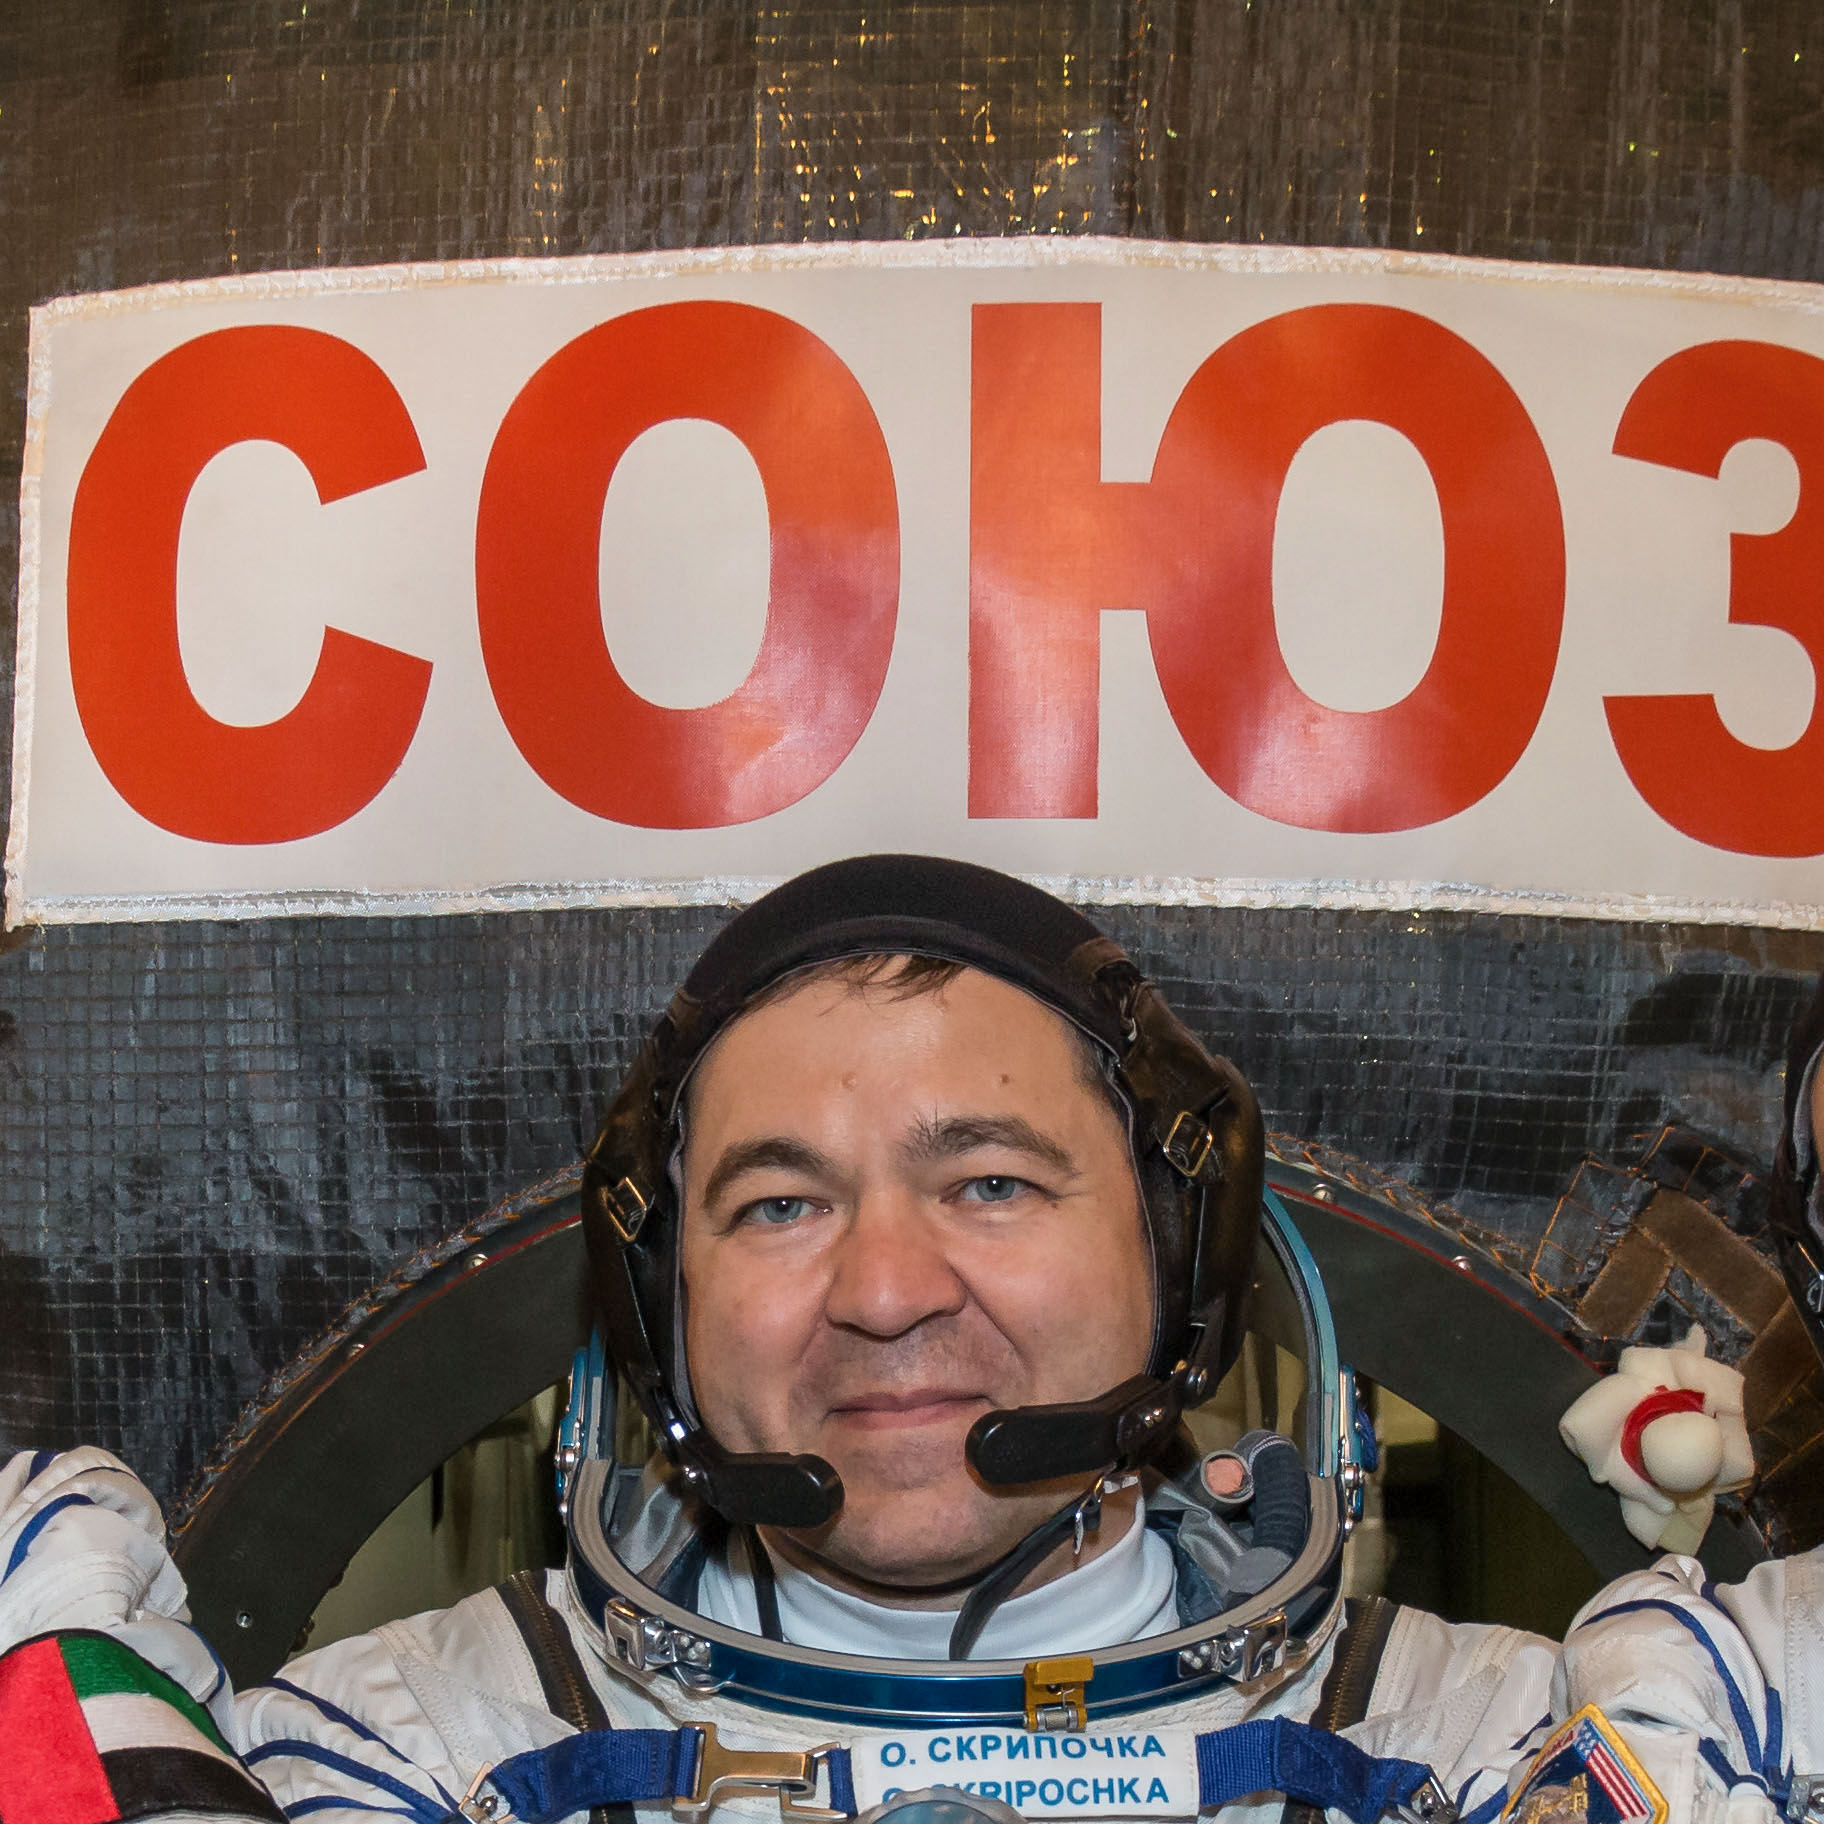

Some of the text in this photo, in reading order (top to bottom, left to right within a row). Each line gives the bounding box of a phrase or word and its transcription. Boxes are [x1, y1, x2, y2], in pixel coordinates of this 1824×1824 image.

[880, 1734, 1166, 1767] О. СКРИПОЧКА
[930, 1777, 1170, 1807] RIPOCHKA
